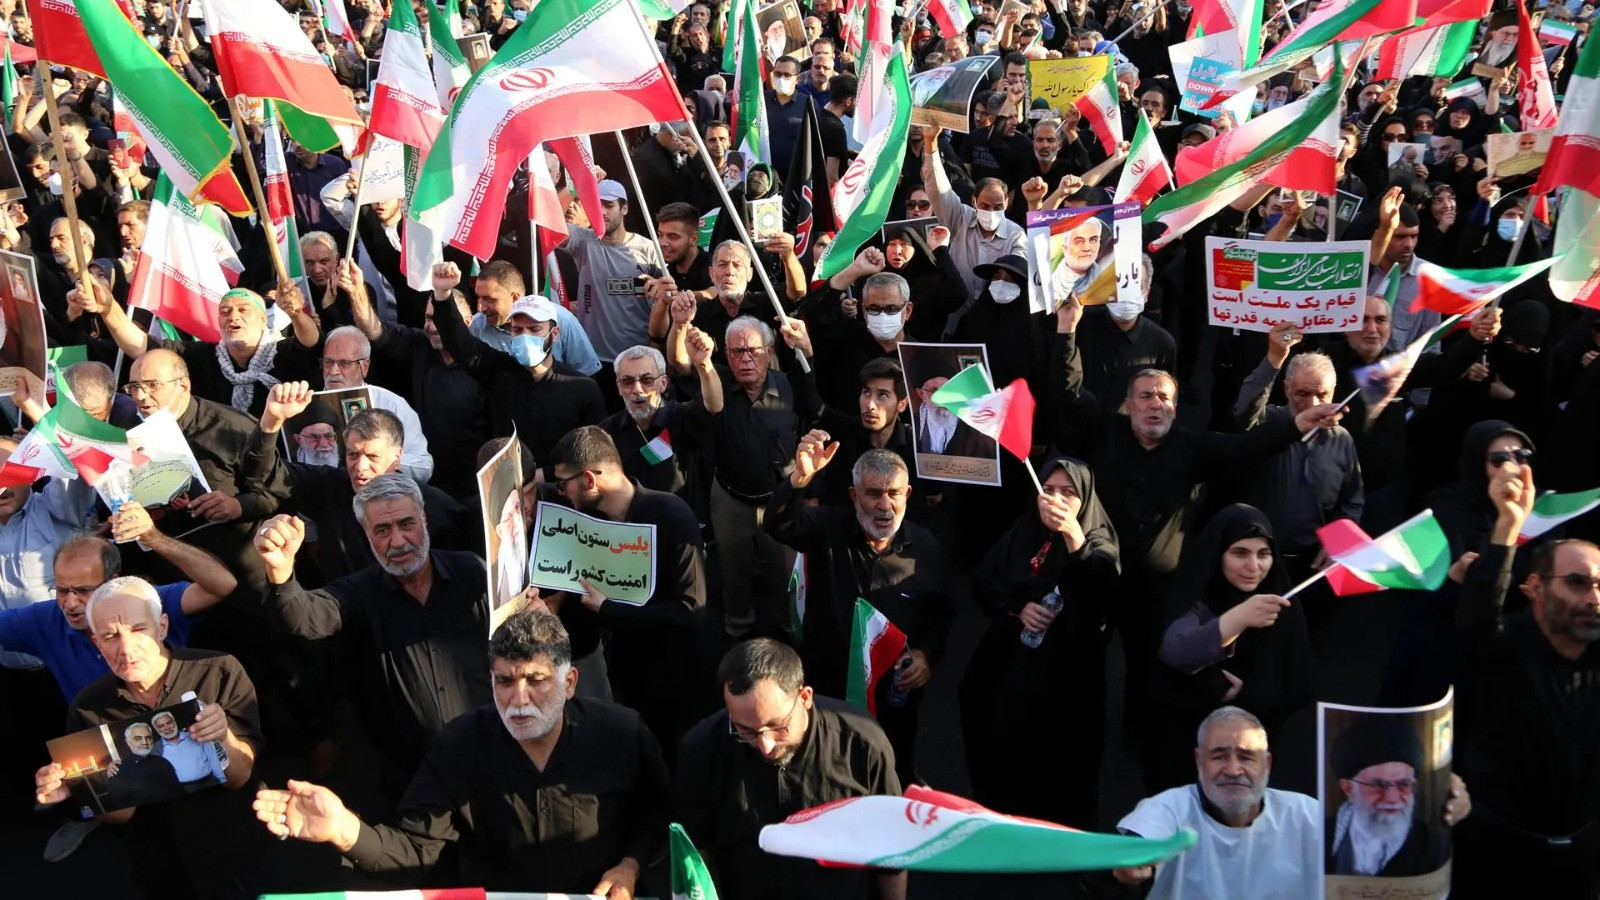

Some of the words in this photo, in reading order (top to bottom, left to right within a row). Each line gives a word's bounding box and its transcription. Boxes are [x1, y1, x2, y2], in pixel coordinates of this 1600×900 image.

[1044, 80, 1056, 93] الله
[1051, 81, 1072, 98] رسول
[1072, 84, 1078, 97] یا
[1188, 82, 1214, 94] DOWN
[1212, 291, 1244, 304] است
[1296, 296, 1320, 311] یک
[1326, 292, 1357, 310] قیام
[1213, 306, 1258, 324] قدرتها
[1295, 314, 1335, 330] مقابل
[1339, 314, 1359, 328] در
[541, 517, 578, 538] اصلی
[577, 530, 610, 548] ستون
[609, 535, 649, 557] پلیس
[537, 558, 573, 575] است
[569, 565, 606, 583] کشور
[605, 573, 647, 591] امنیت
